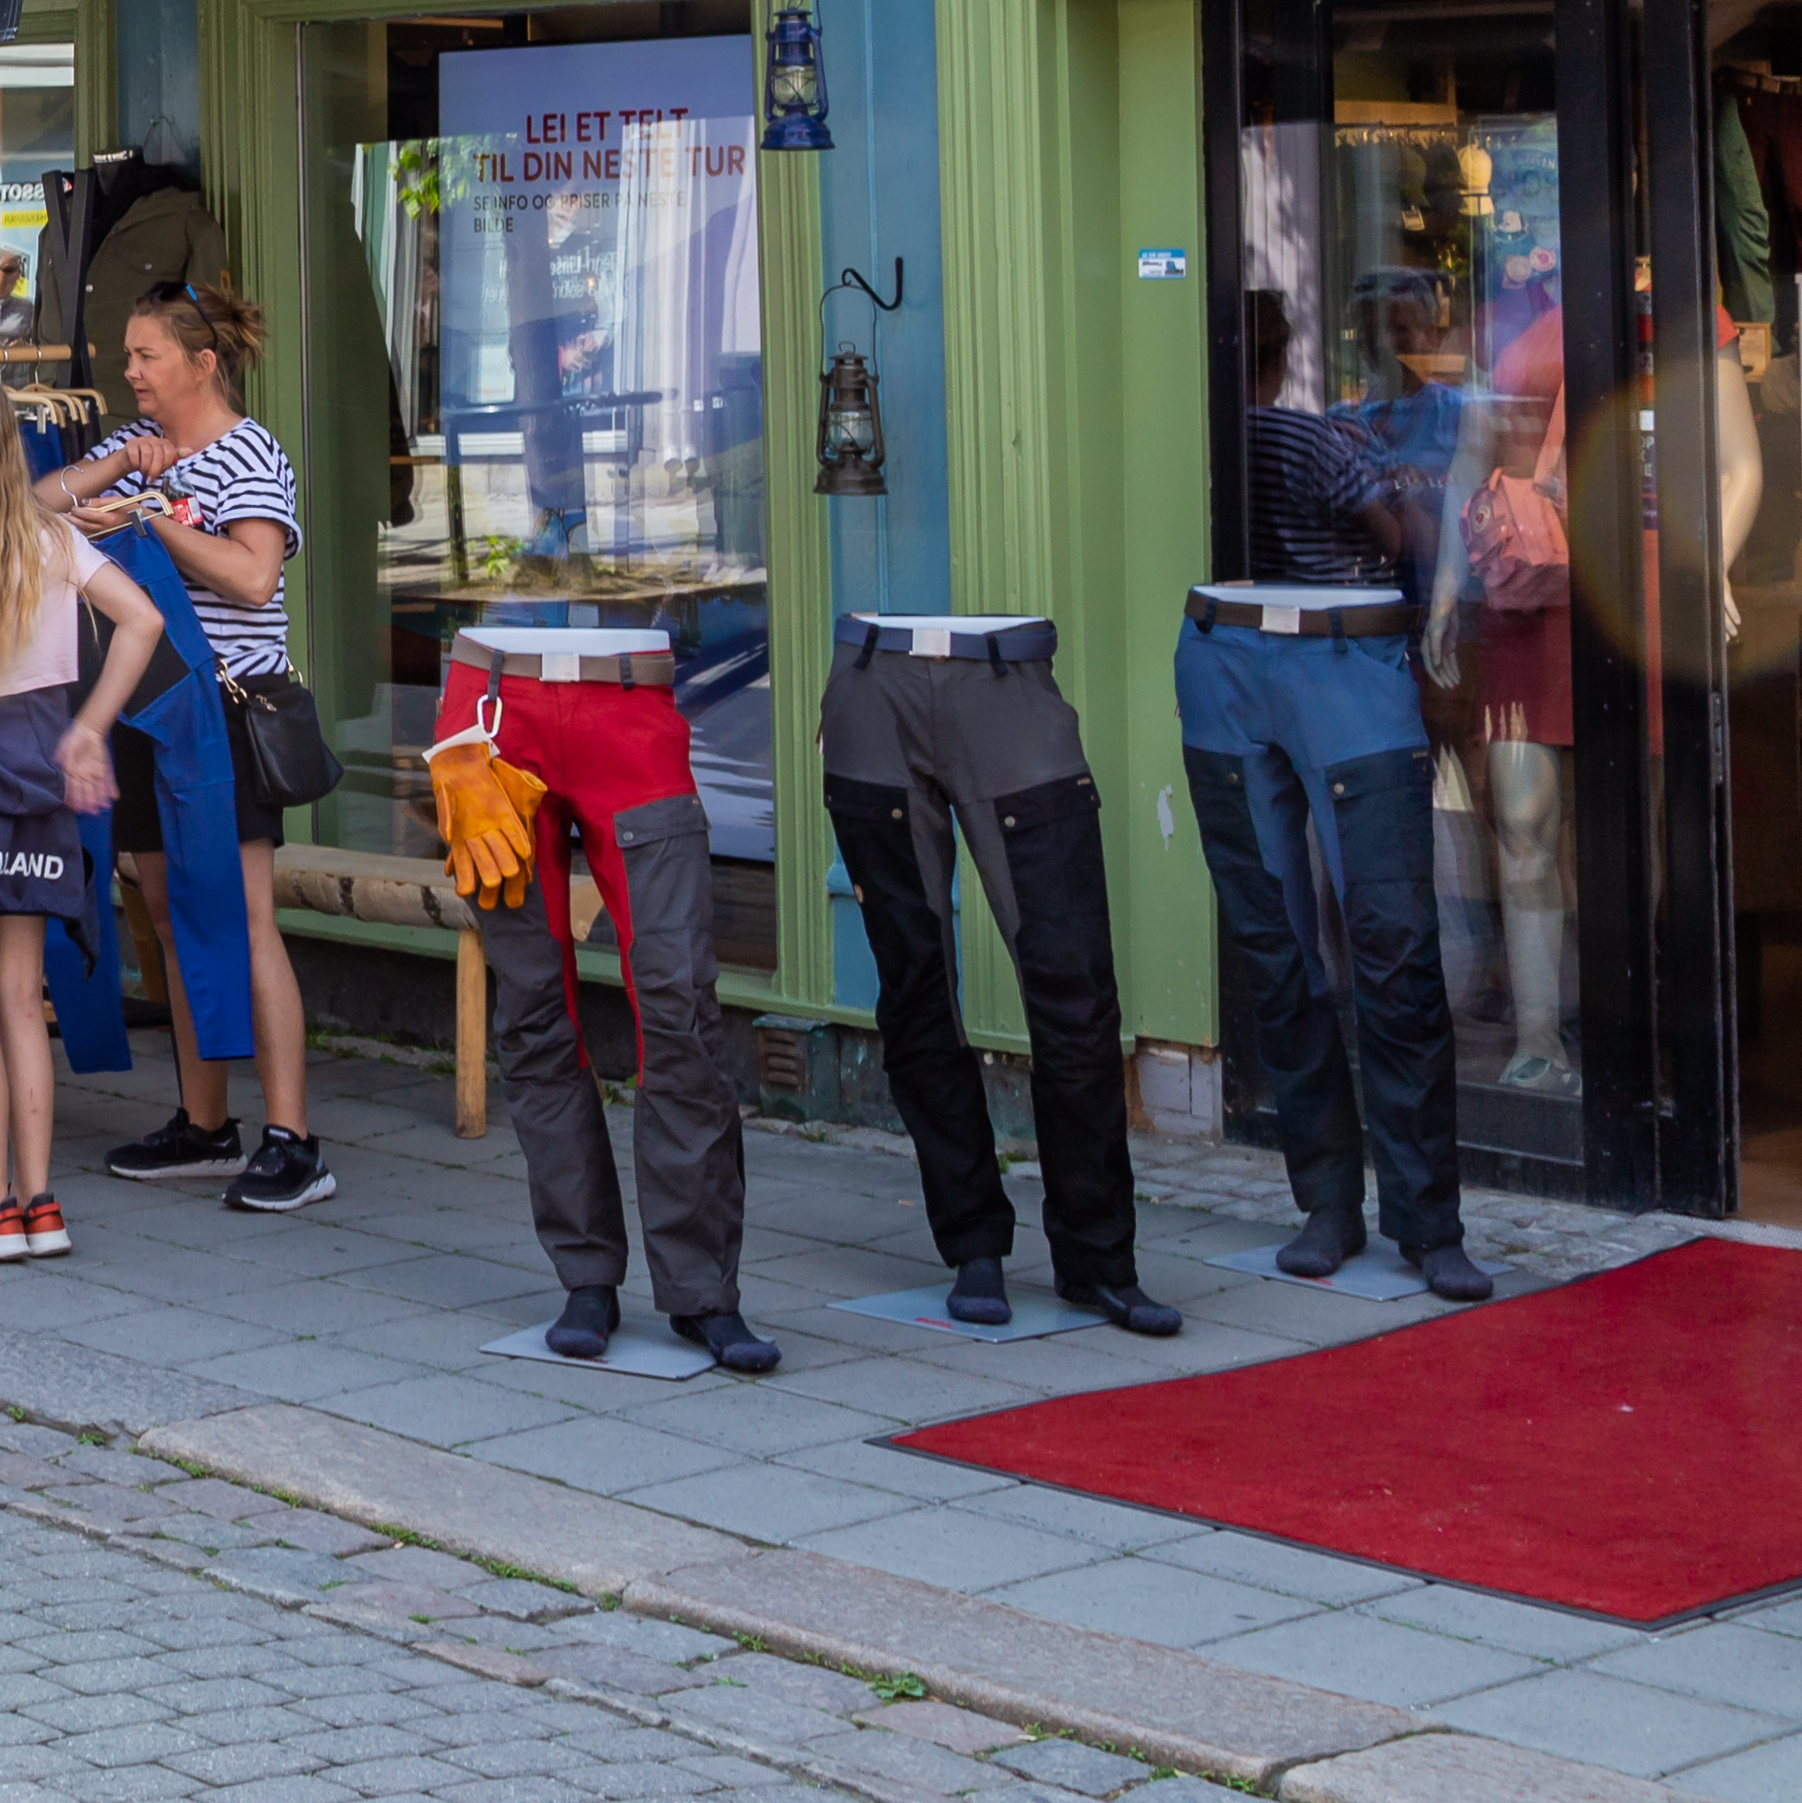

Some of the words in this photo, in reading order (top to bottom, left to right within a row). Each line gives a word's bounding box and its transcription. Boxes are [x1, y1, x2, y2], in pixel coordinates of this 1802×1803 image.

[526, 113, 566, 144] LEI
[576, 111, 611, 142] ET
[618, 108, 689, 140] TELT
[473, 152, 514, 182] TIL
[523, 150, 572, 182] DIN
[583, 148, 676, 179] NESTE
[685, 145, 745, 177] TUR
[494, 194, 528, 210] INFO
[532, 194, 554, 210] OG
[560, 193, 610, 209] PRISER
[474, 217, 514, 233] BILDE
